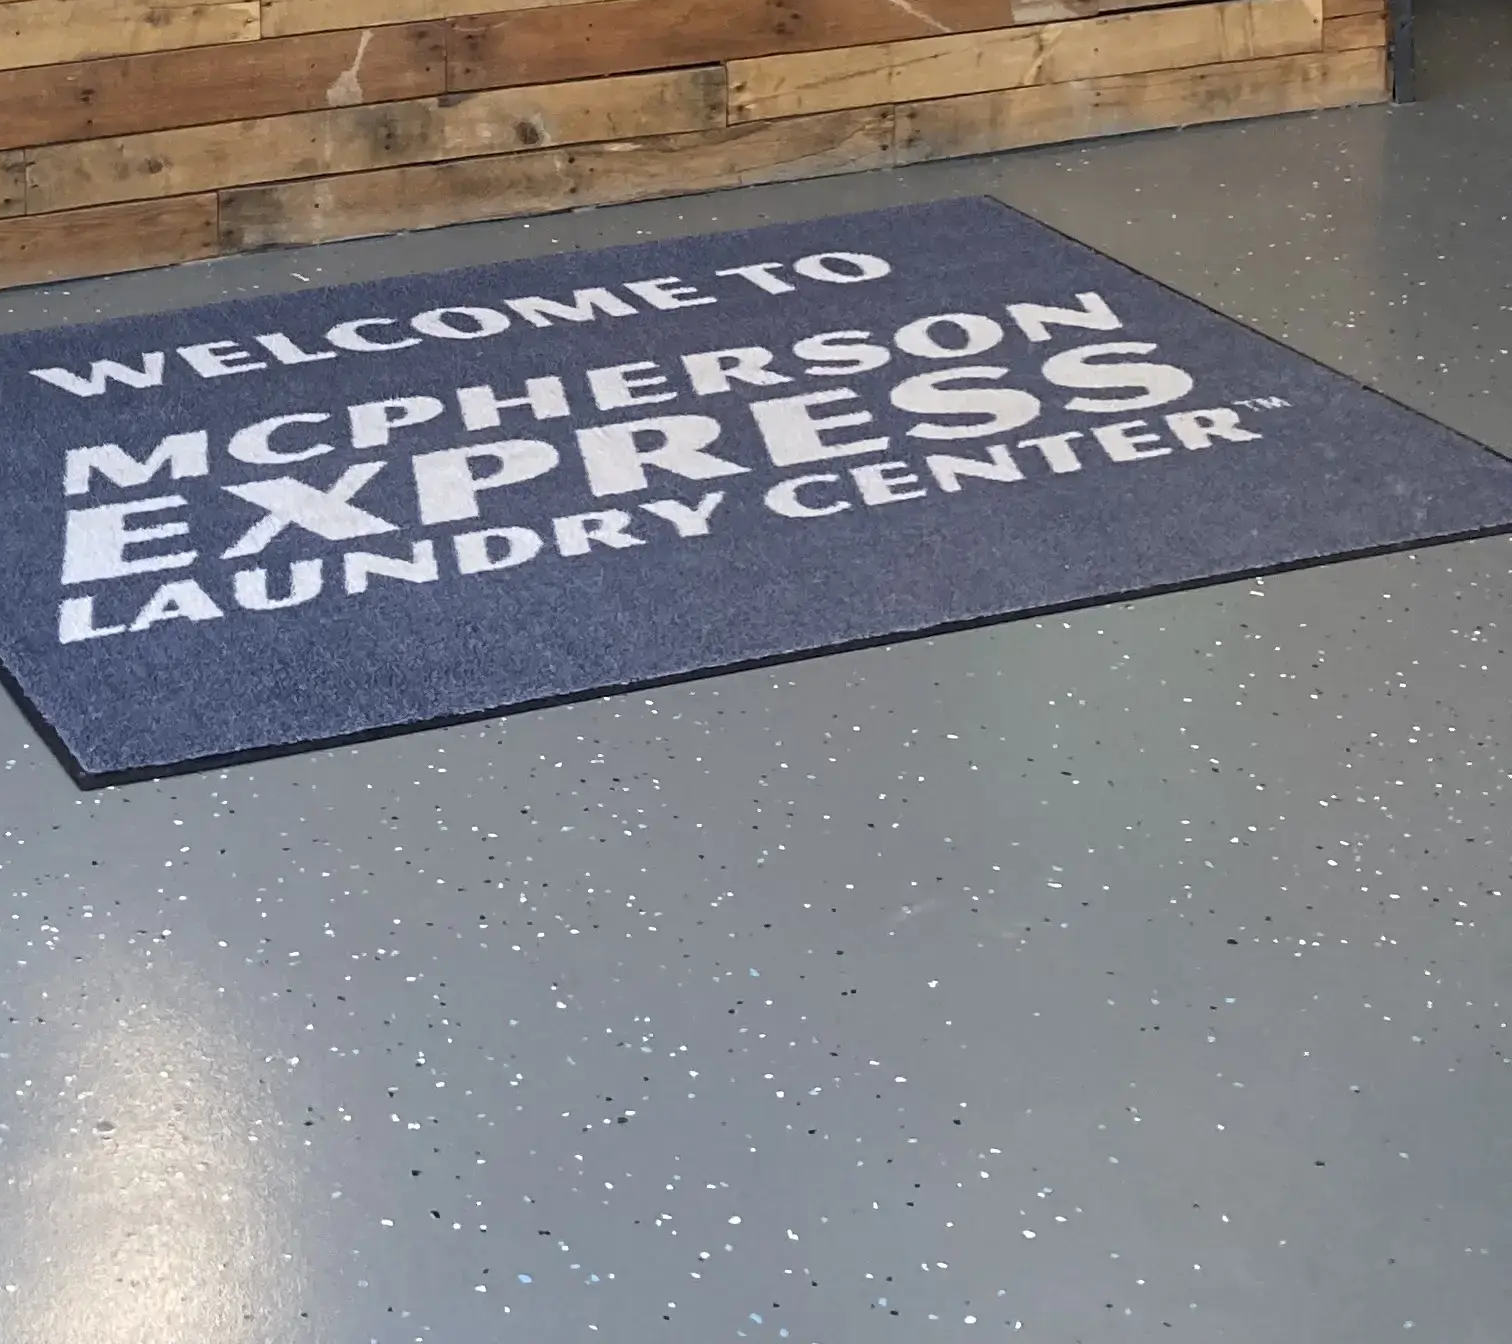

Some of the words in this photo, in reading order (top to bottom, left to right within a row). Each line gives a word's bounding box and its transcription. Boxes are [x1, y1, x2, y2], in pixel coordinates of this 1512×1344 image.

[29, 275, 717, 398] WELCOME
[716, 251, 891, 296] TO
[63, 291, 1123, 496] MCPHERSON
[61, 342, 1192, 585] EXPRESS
[58, 491, 725, 645] LAUNDRY
